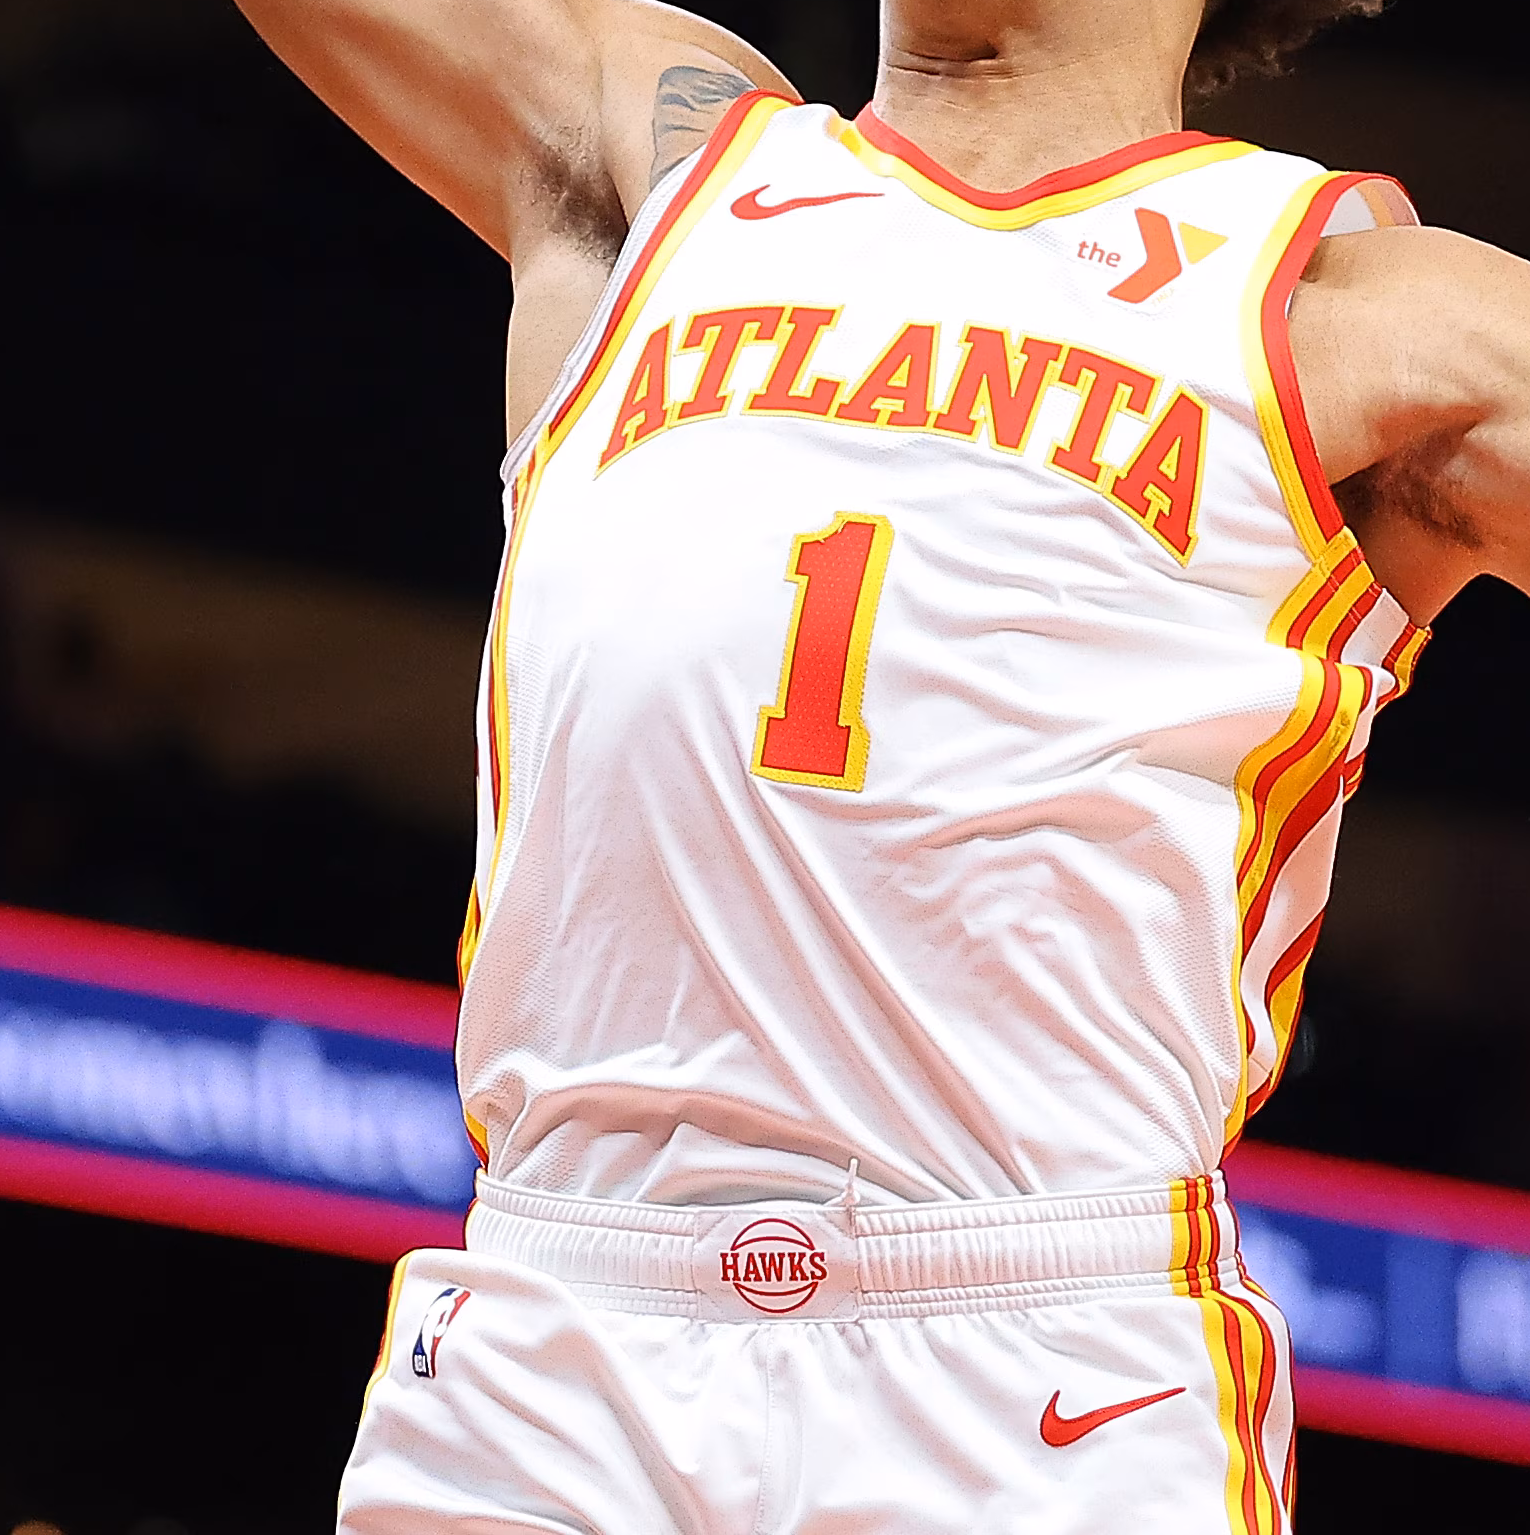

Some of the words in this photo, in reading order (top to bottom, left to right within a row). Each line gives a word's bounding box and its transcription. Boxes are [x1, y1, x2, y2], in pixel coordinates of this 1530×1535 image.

[1077, 240, 1121, 267] the
[595, 302, 1209, 567] ATLANTA
[750, 510, 895, 792] 1
[720, 1252, 828, 1282] HAWKS
